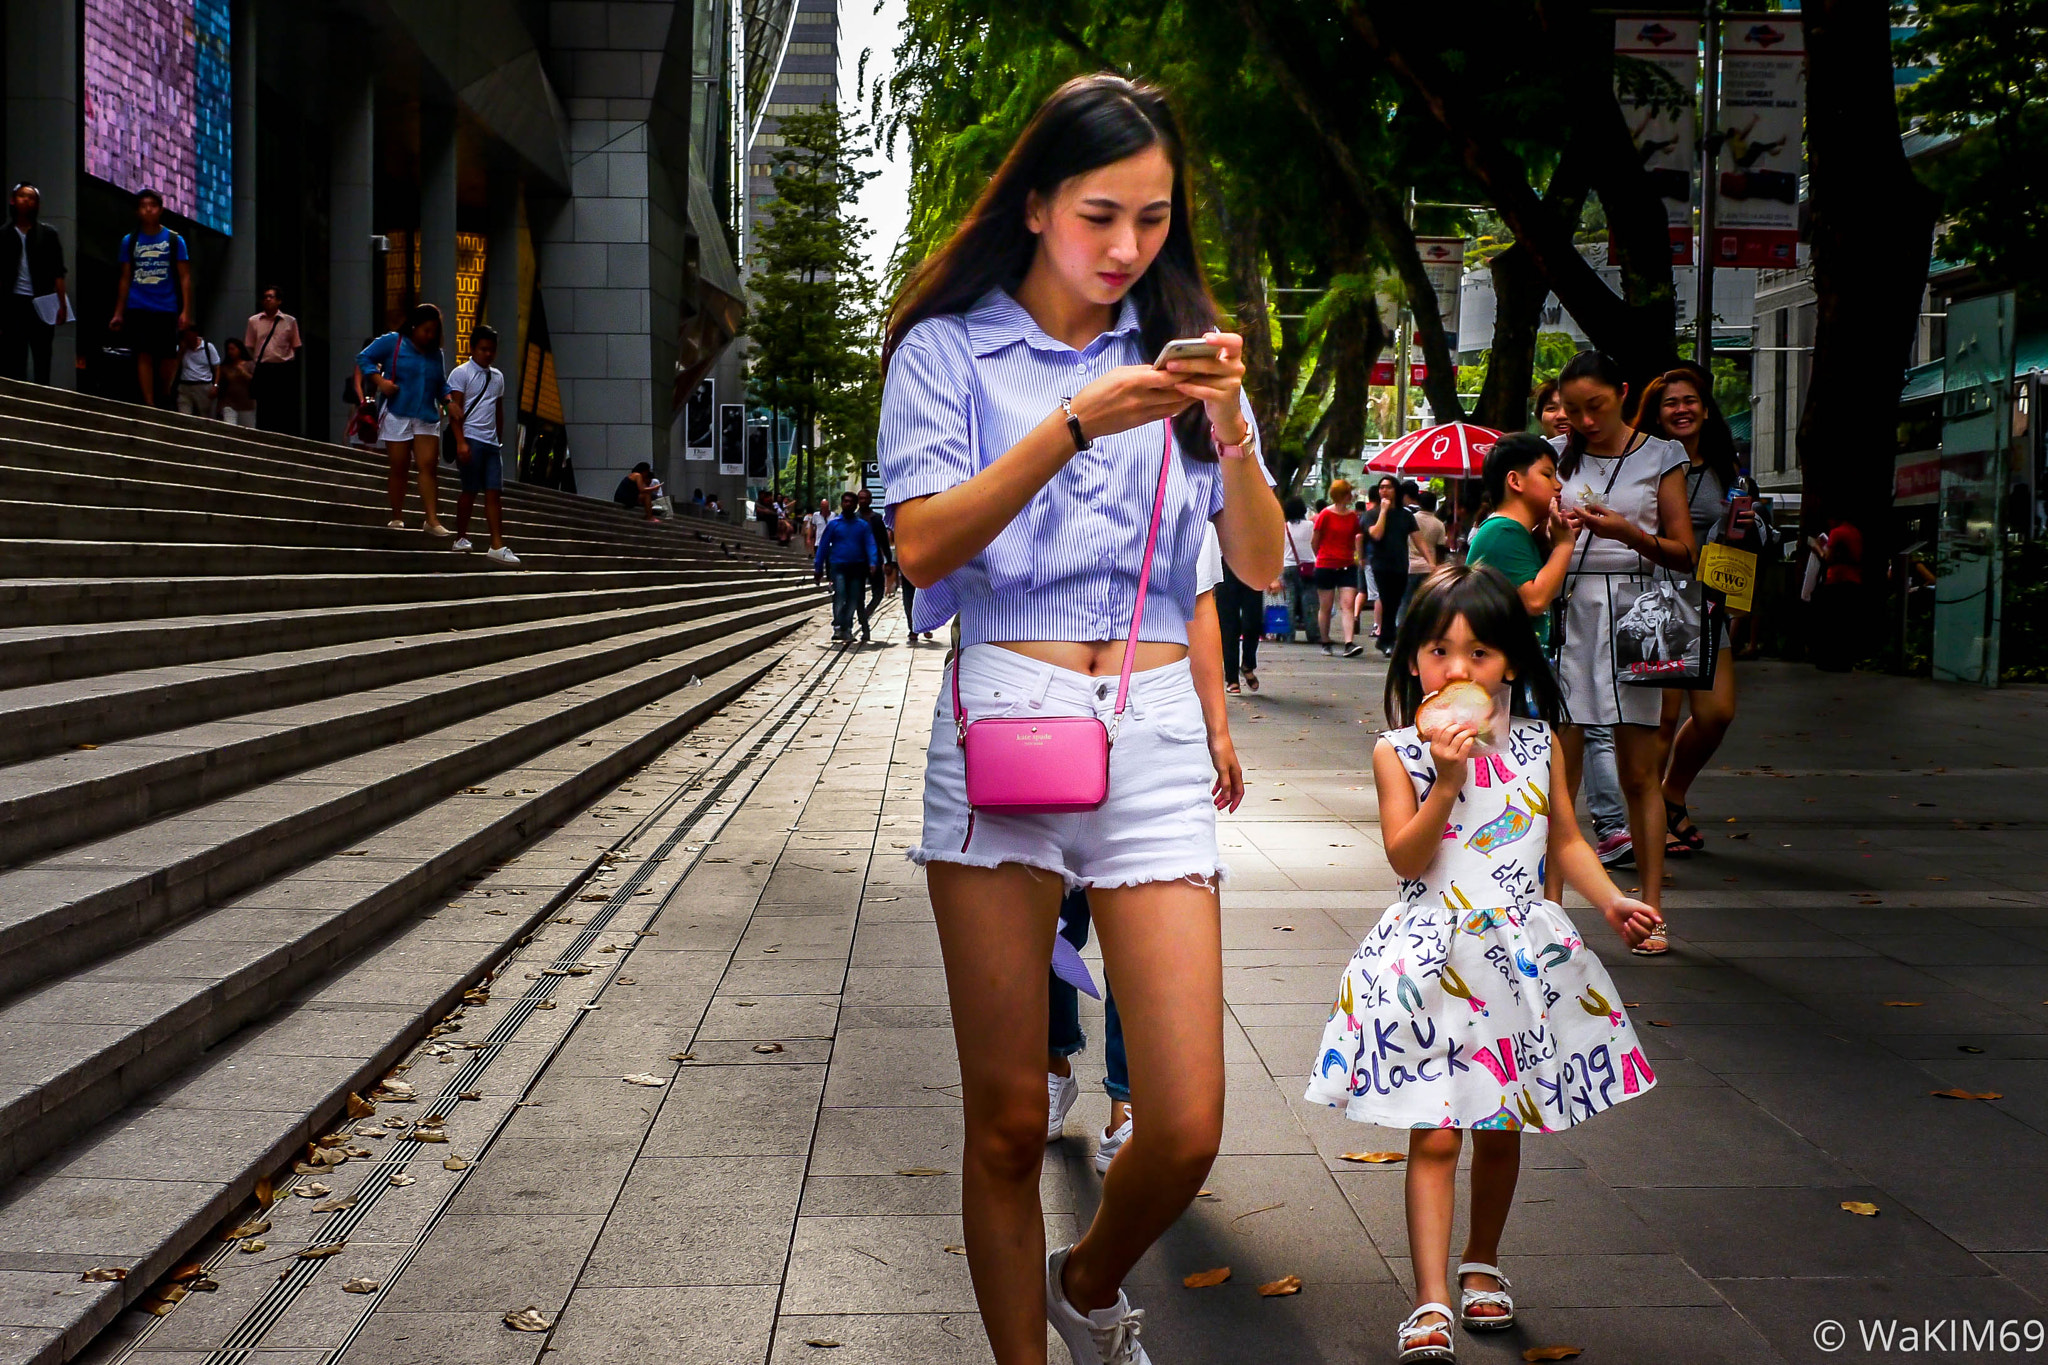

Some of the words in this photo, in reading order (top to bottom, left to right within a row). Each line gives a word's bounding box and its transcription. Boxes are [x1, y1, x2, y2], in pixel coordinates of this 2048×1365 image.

[866, 462, 880, 473] IO
[1713, 570, 1745, 588] TWG
[1631, 659, 1685, 674] GUESS
[1016, 733, 1031, 741] kate
[1032, 733, 1053, 741] spade
